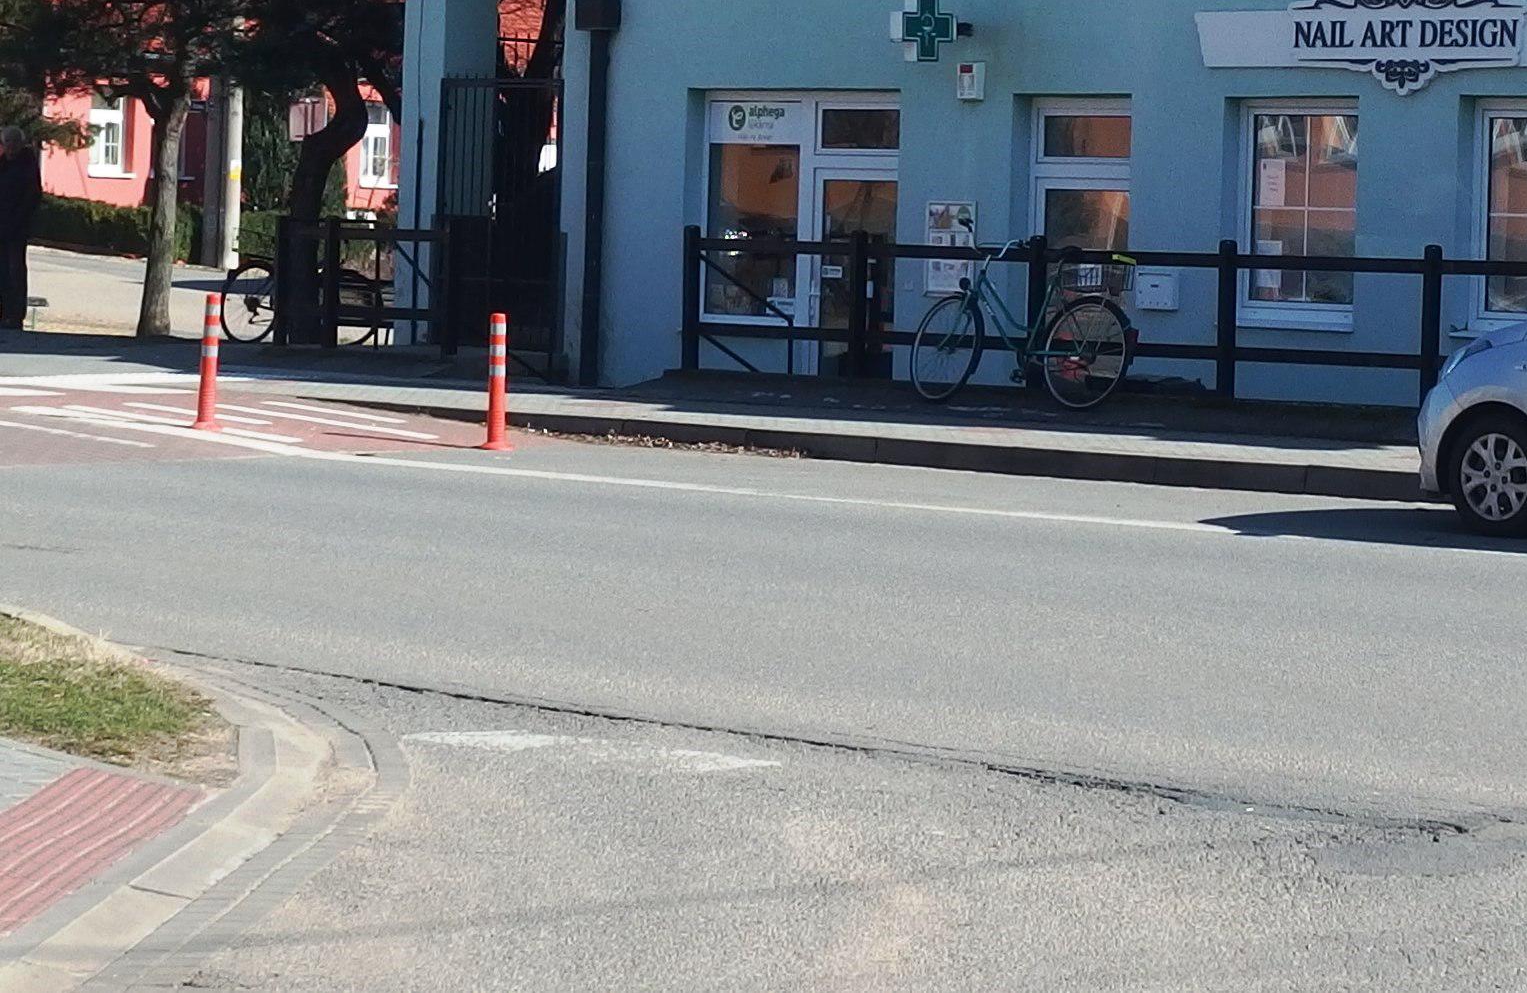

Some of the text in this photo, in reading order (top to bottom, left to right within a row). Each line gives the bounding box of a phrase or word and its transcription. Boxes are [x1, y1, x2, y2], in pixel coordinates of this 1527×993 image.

[1293, 19, 1519, 48] NAIL ART DESIGN
[749, 105, 785, 119] alphega
